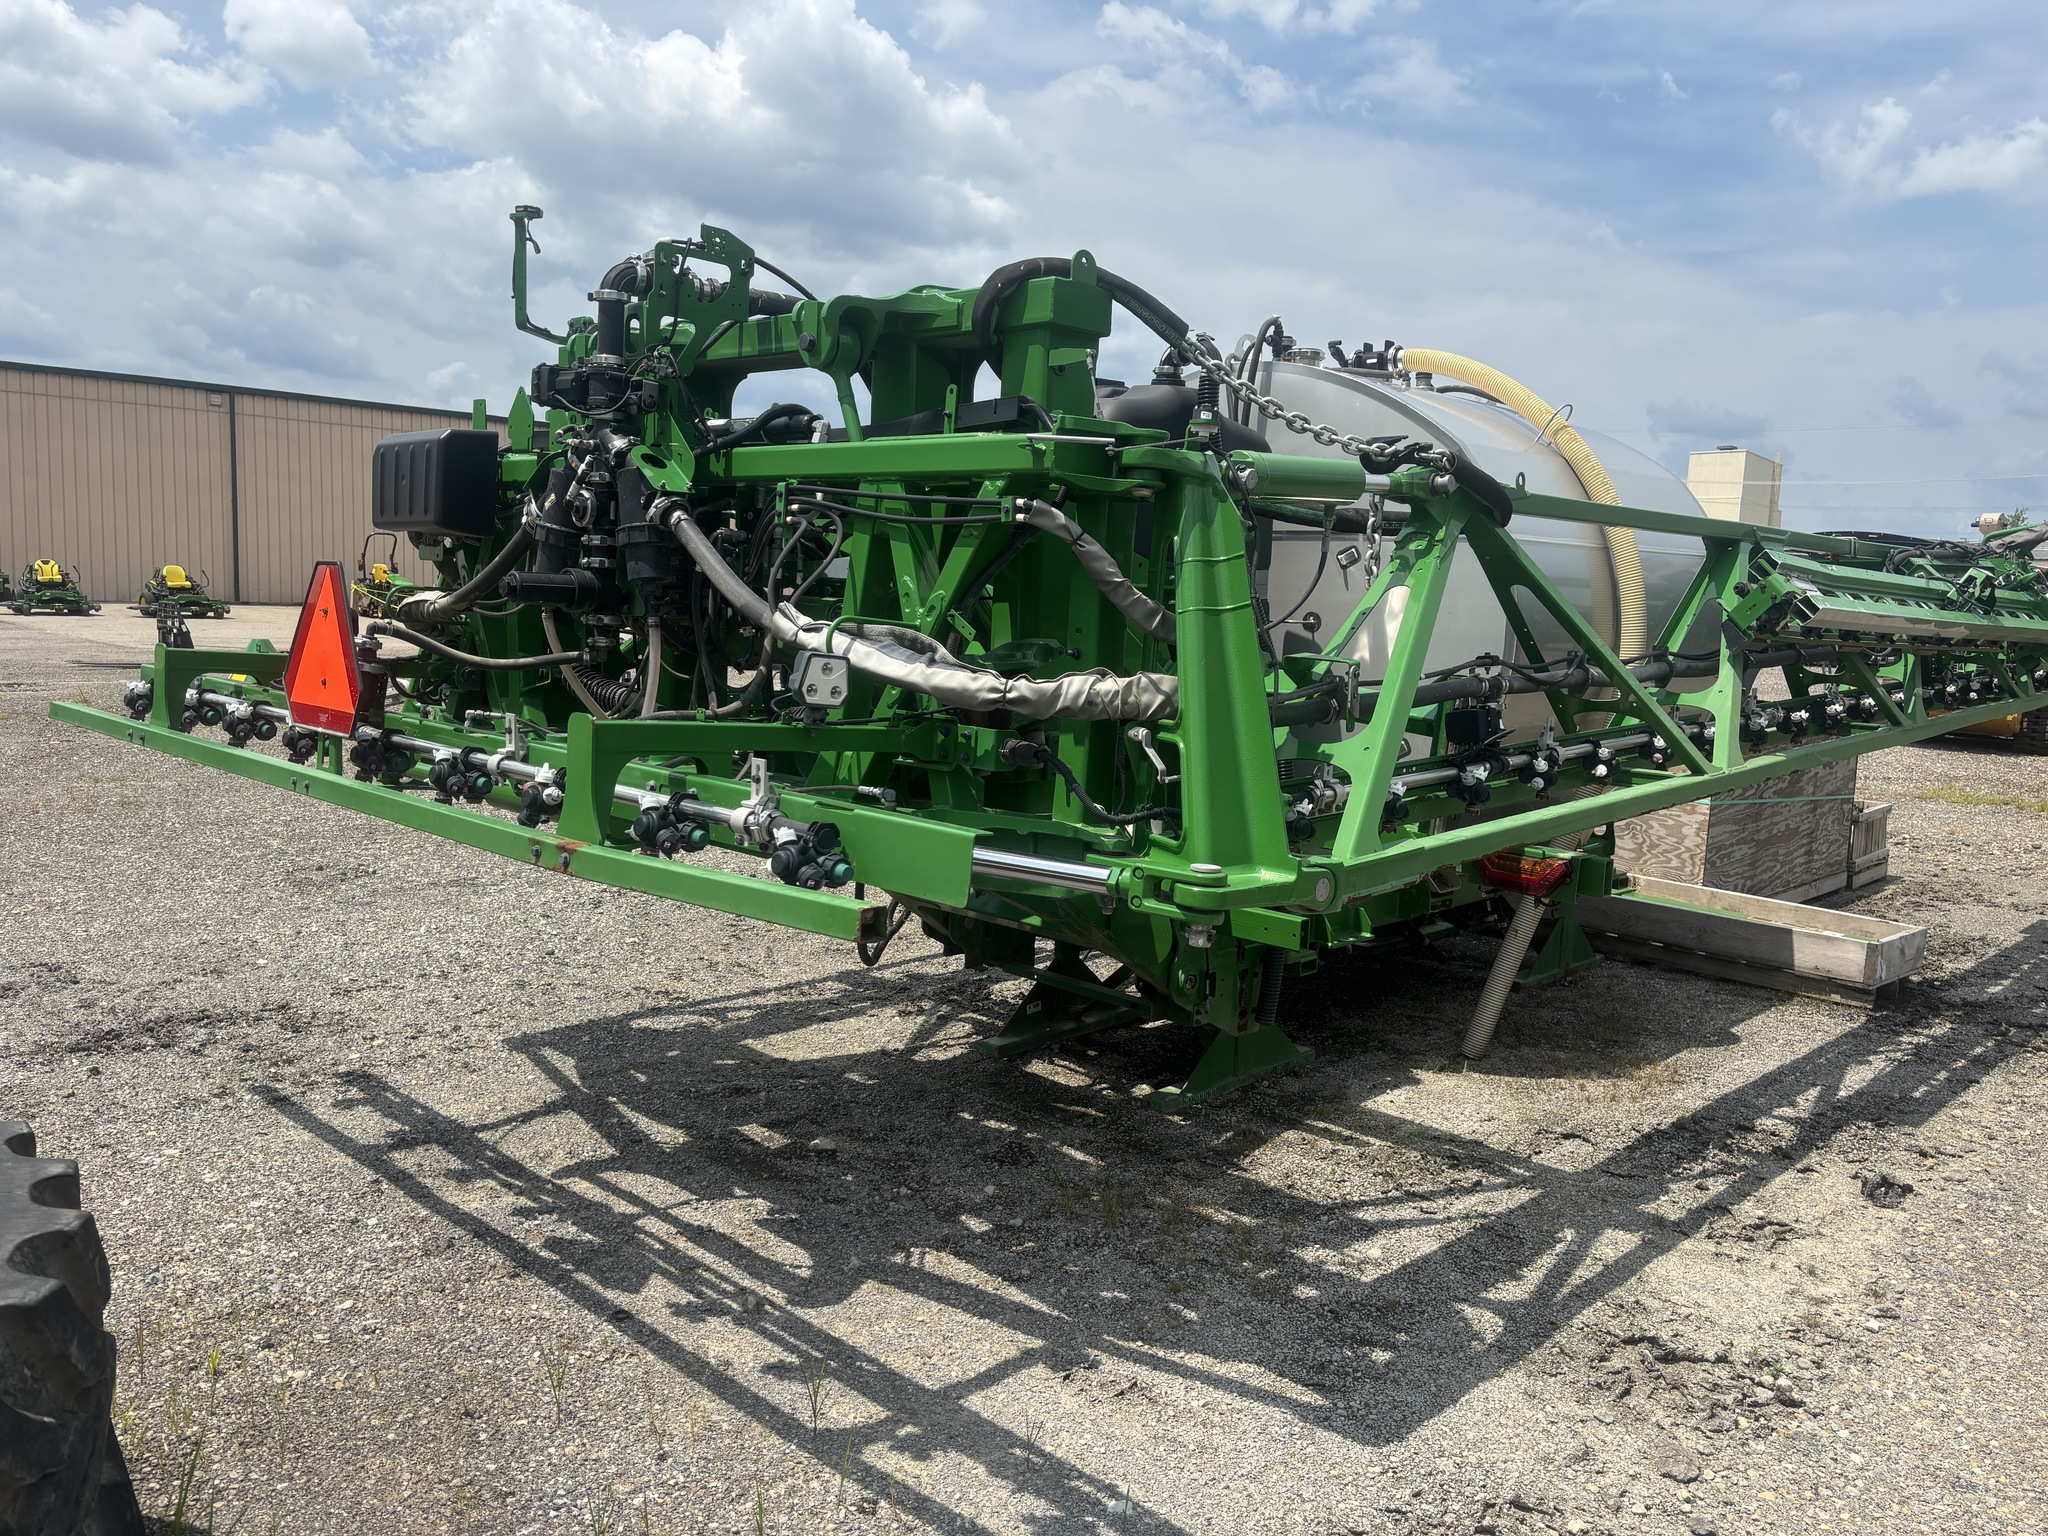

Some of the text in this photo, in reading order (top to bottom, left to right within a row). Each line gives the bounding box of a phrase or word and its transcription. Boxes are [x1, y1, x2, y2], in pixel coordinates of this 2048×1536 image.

[1113, 289, 1182, 345] ATER DISCHARGE HOS
